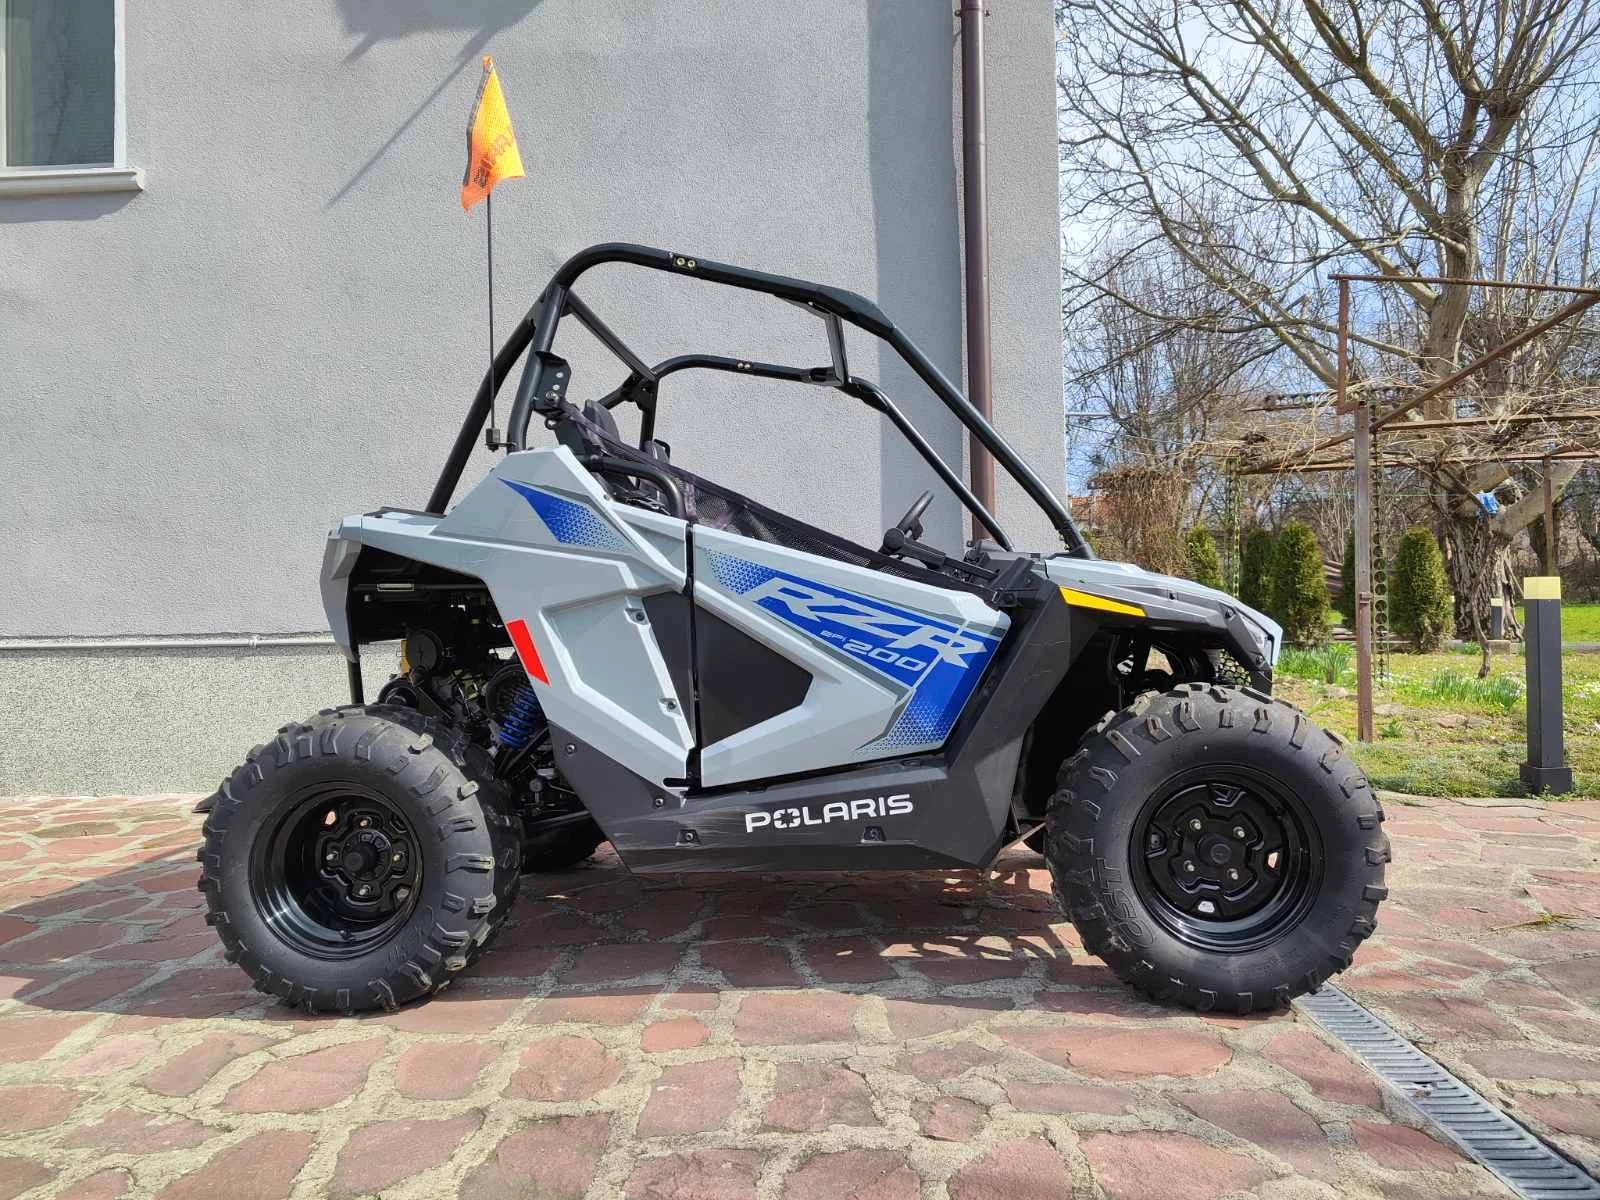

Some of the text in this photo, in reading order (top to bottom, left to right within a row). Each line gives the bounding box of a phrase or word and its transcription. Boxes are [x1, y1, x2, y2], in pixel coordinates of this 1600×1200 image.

[752, 577, 988, 669] RZR
[842, 638, 927, 672] 200
[744, 793, 914, 833] POLARIS
